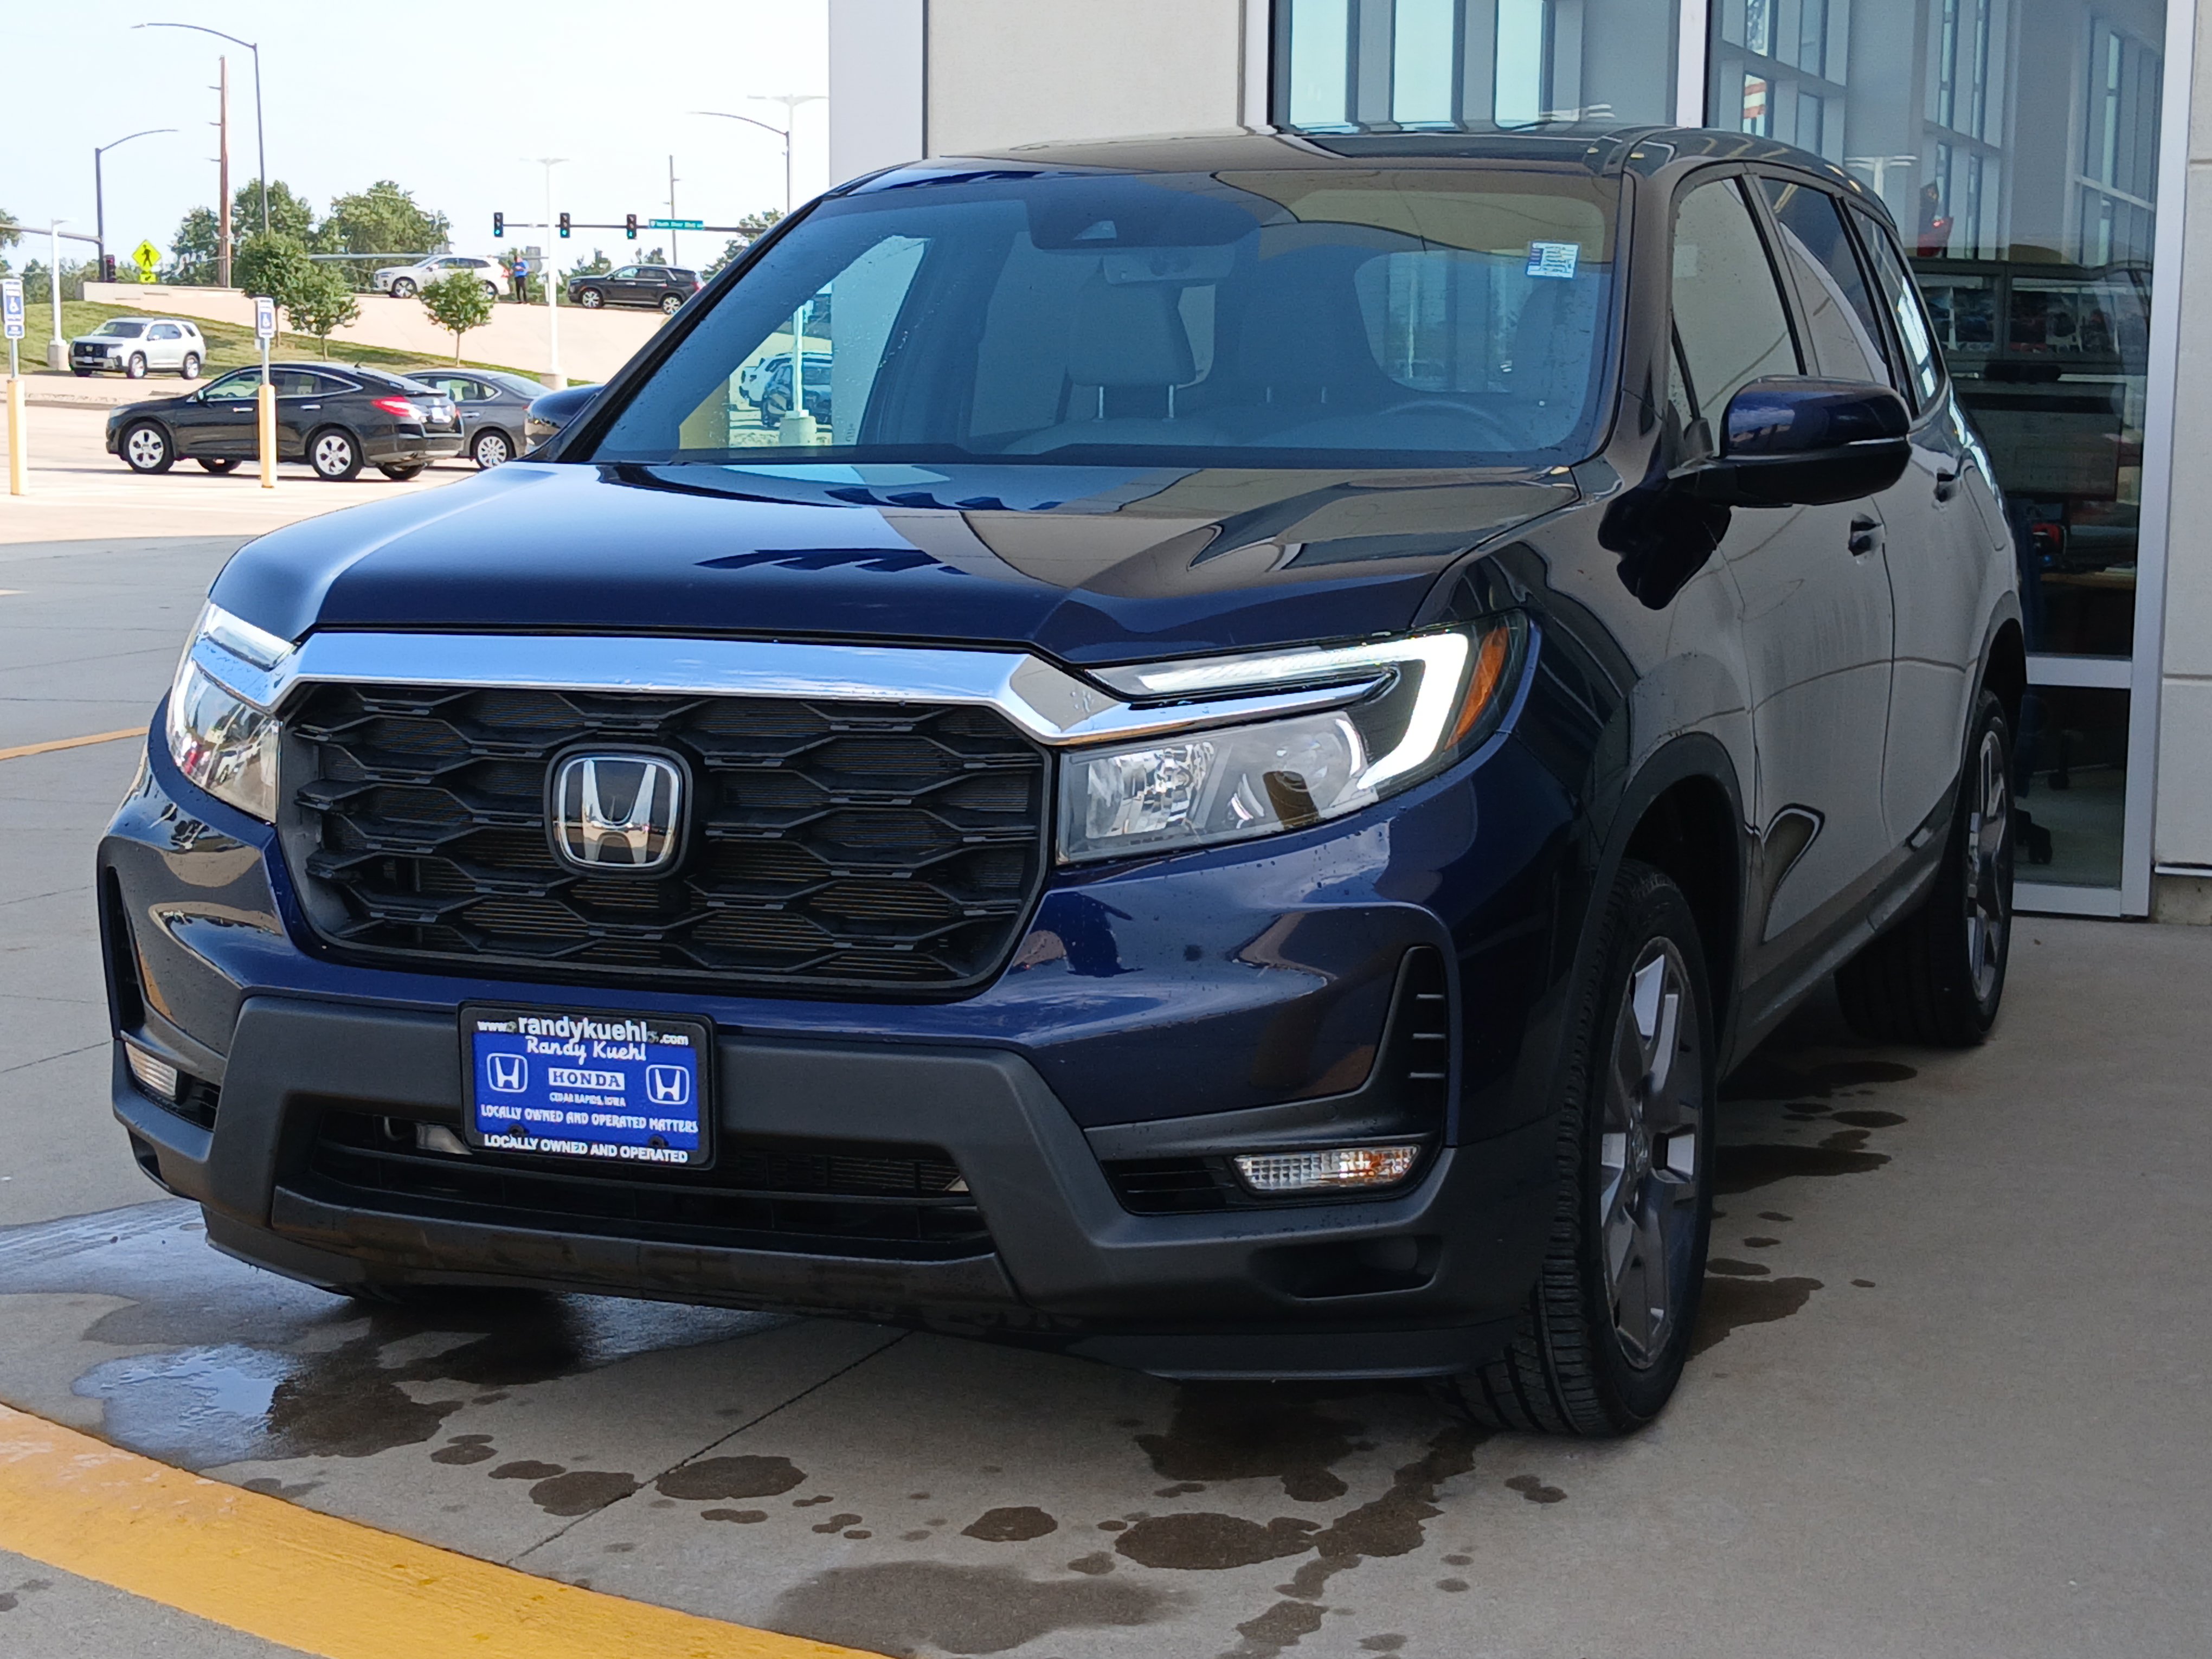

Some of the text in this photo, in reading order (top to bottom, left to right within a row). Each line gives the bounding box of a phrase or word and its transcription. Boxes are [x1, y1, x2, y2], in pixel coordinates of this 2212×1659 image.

[518, 1015, 647, 1043] randykuehl
[524, 1035, 647, 1065] Randy Kuehl
[552, 1071, 621, 1088] HONDA
[480, 1104, 699, 1134] LOCALLY OWNED AND OPERATED MATTERS
[484, 1134, 688, 1163] LOCALLY OWNED AND OPERATED
